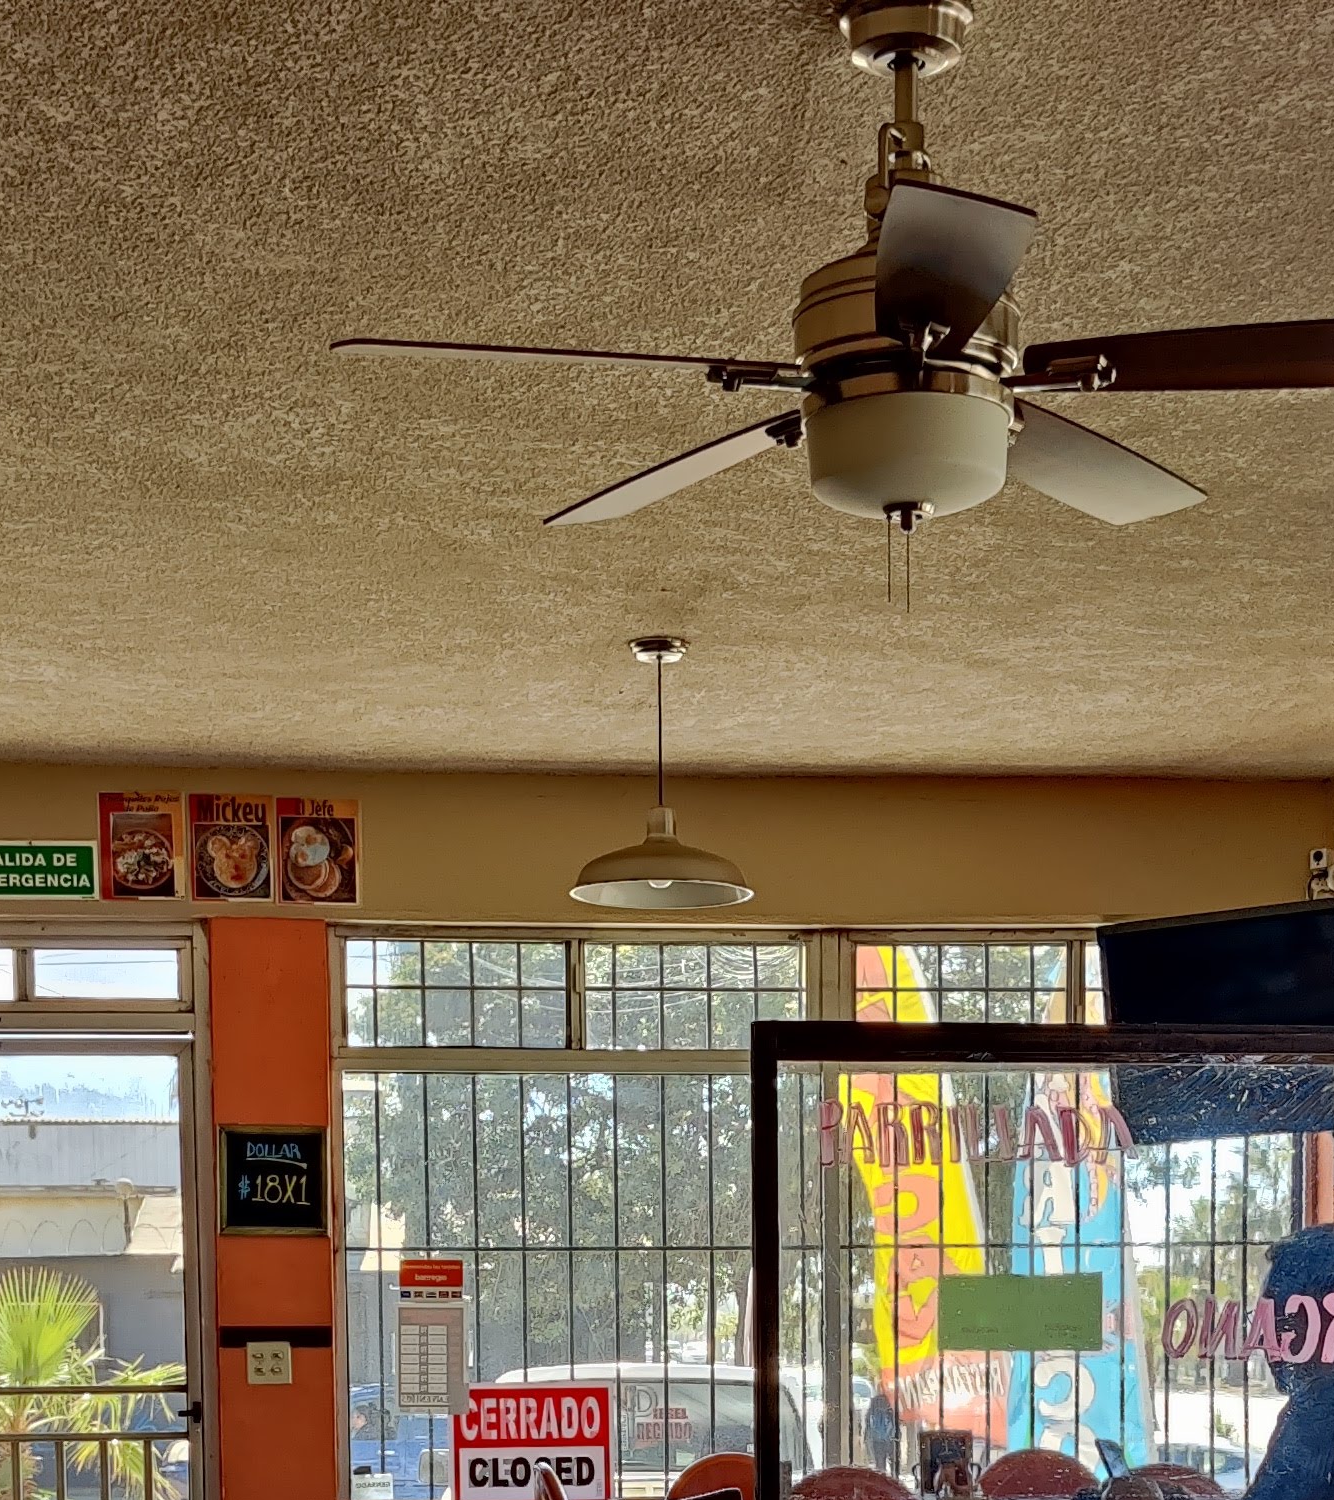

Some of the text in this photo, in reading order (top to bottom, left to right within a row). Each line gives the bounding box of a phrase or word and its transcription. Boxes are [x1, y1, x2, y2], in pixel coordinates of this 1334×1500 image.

[198, 794, 267, 823] Mickey
[52, 853, 78, 867] DE
[246, 1141, 301, 1160] DOLLAR
[460, 1396, 601, 1441] CERRADO
